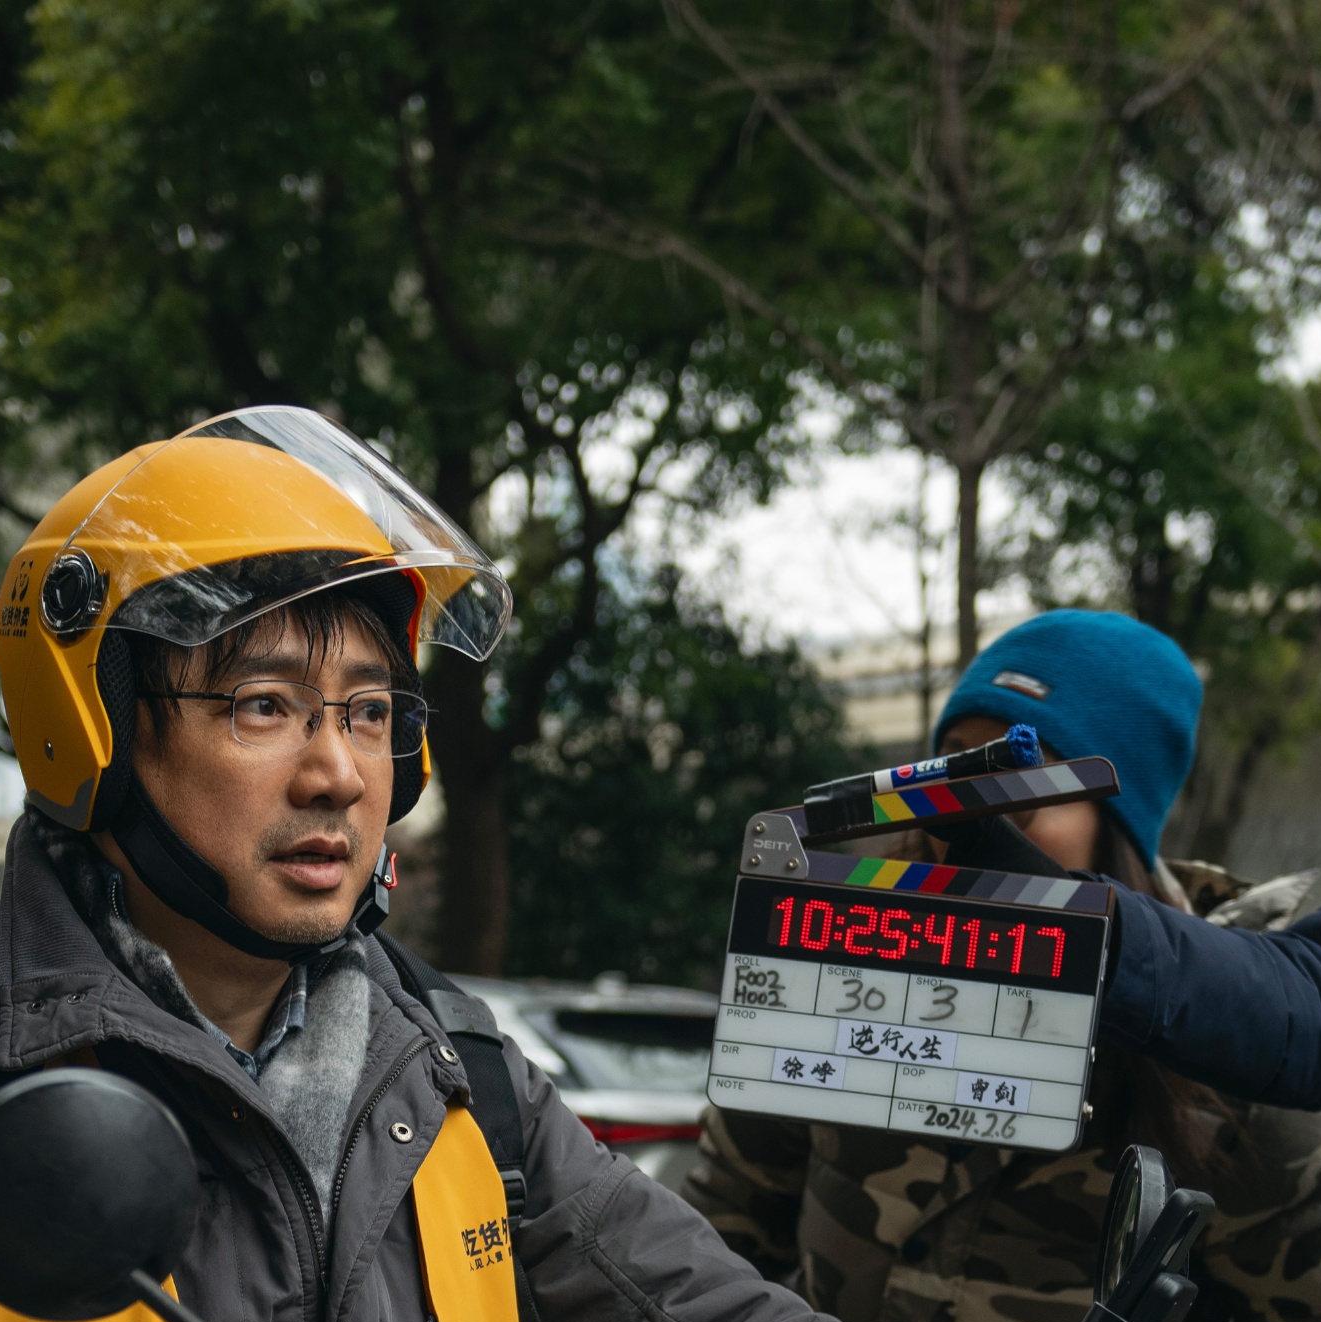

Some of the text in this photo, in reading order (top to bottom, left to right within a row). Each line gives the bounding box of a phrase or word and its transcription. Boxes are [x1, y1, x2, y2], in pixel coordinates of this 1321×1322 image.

[752, 838, 793, 851] DEITY
[776, 896, 1066, 978] 10:25:41:17
[734, 955, 761, 967] ROLL
[827, 966, 863, 979] SCENE
[915, 977, 944, 989] SHOT
[835, 978, 886, 1013] 30
[1006, 987, 1033, 999] TAKE
[918, 985, 959, 1022] 3
[726, 1008, 757, 1020] PROD
[1019, 1000, 1033, 1039] 1
[848, 1024, 943, 1061] 逆行人生
[721, 1044, 740, 1055] DIR
[902, 1067, 926, 1078] DOP
[716, 1078, 745, 1091] NOTE
[897, 1101, 925, 1113] DATE
[924, 1105, 1019, 1139] 2024.2.6
